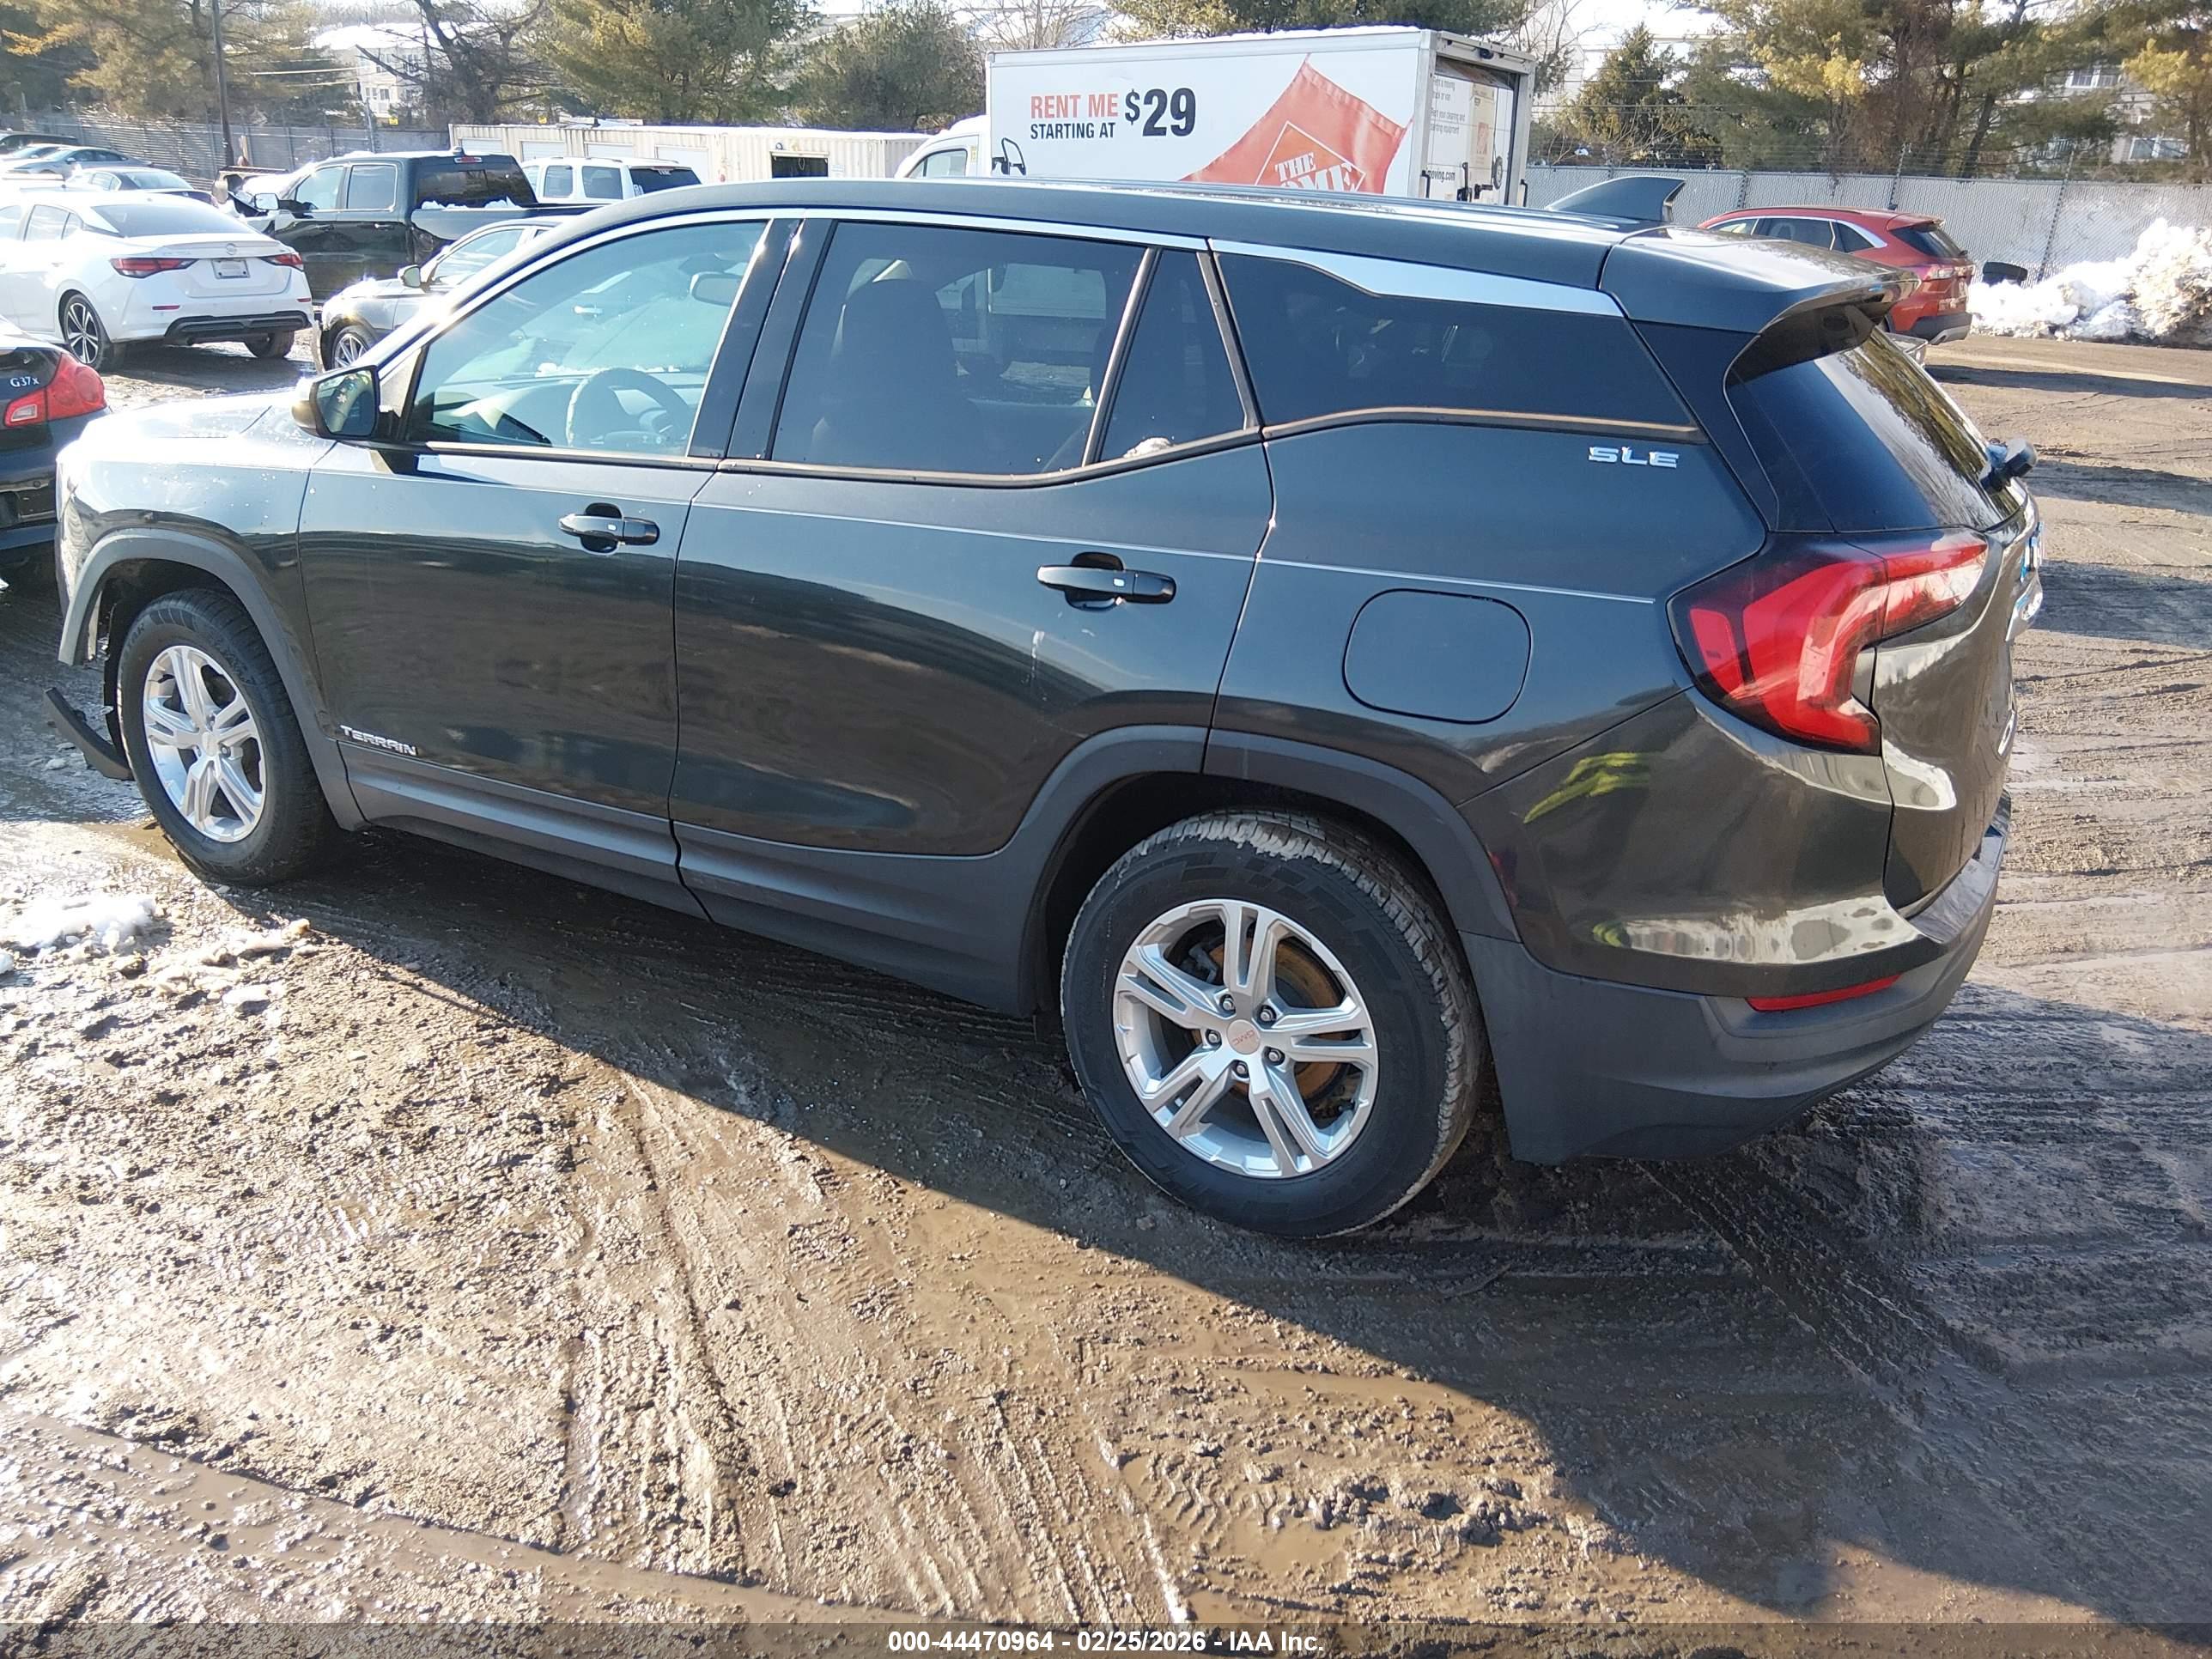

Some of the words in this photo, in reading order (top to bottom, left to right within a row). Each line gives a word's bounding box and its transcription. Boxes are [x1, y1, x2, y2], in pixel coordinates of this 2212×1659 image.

[1030, 94, 1081, 118] RENT
[1088, 94, 1119, 118] ME
[1125, 88, 1196, 137] $29
[1030, 123, 1095, 139] STARTING
[1099, 122, 1116, 138] AT
[1274, 152, 1316, 182] THE
[9, 376, 40, 387] G37x
[1589, 447, 1680, 469] SLE
[340, 725, 417, 756] TERRAIN
[1232, 1030, 1255, 1046] GMC
